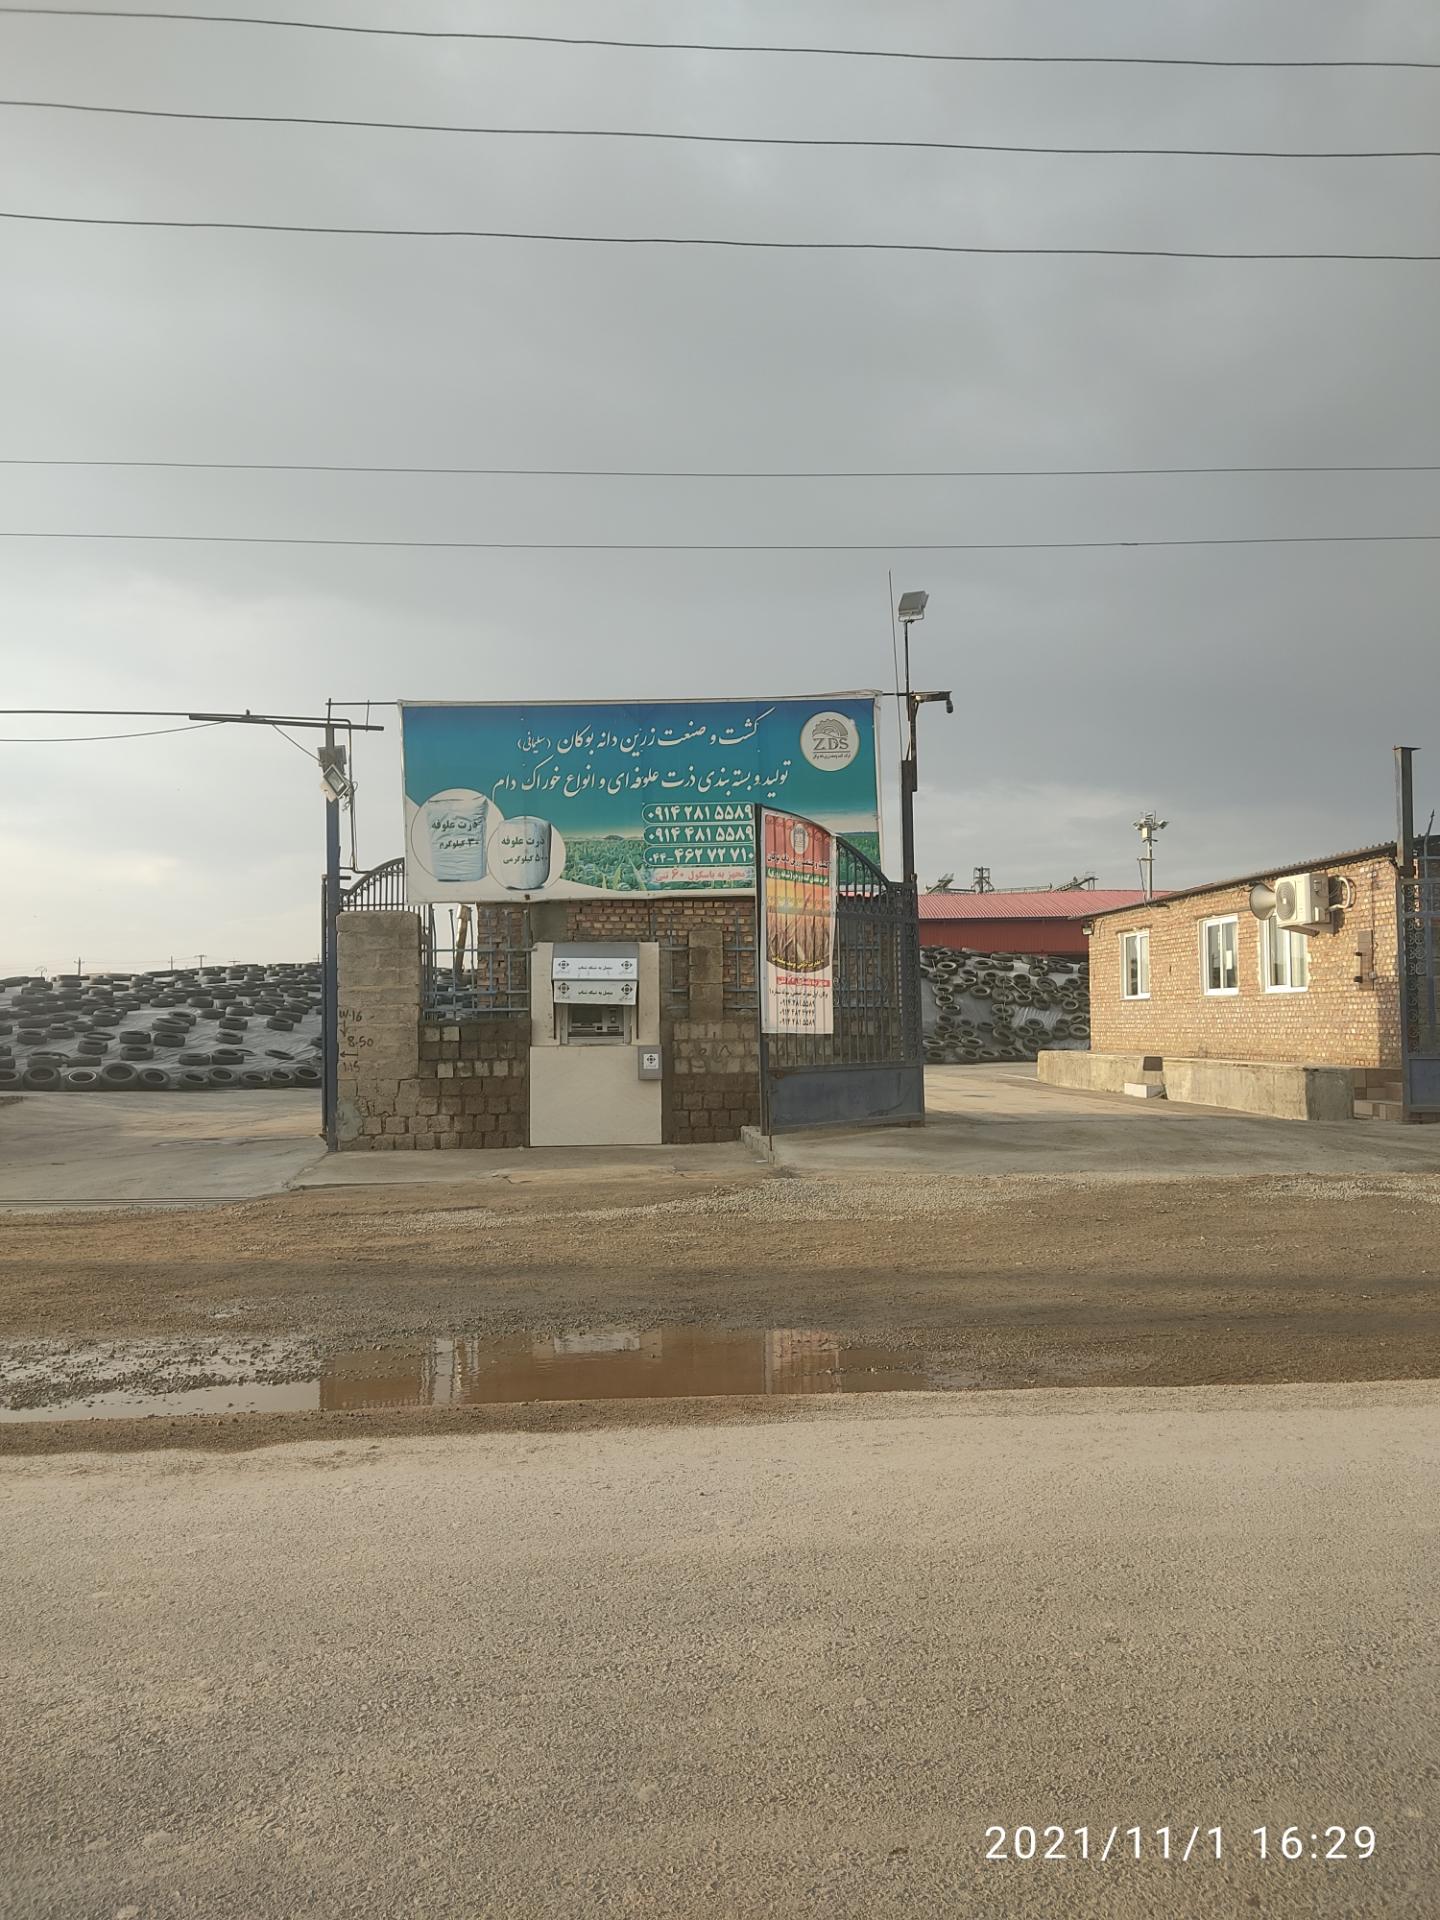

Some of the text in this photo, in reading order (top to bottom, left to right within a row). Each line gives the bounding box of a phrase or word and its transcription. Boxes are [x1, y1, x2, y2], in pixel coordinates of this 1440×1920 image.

[657, 720, 707, 746] صنعت
[718, 706, 776, 746] کشت
[556, 724, 594, 755] بوکان
[596, 730, 618, 748] دانه
[619, 728, 657, 757] زرین
[708, 734, 717, 746] و
[813, 737, 849, 750] ZDS
[521, 755, 561, 791] خوراک
[563, 766, 595, 798] انواع
[598, 776, 605, 789] و
[661, 767, 696, 788] ذرت
[753, 773, 760, 786] و
[763, 759, 792, 798] تولید
[492, 773, 516, 803] دام
[648, 804, 753, 821] ۰۹۱۴ ۲۸۱ ۵۵۸۹
[648, 825, 754, 842] ۰۹۱۴ ۴۸۱ ۵۵۸۹
[707, 847, 726, 863] ۷۲
[730, 847, 754, 863] ۷۱۰
